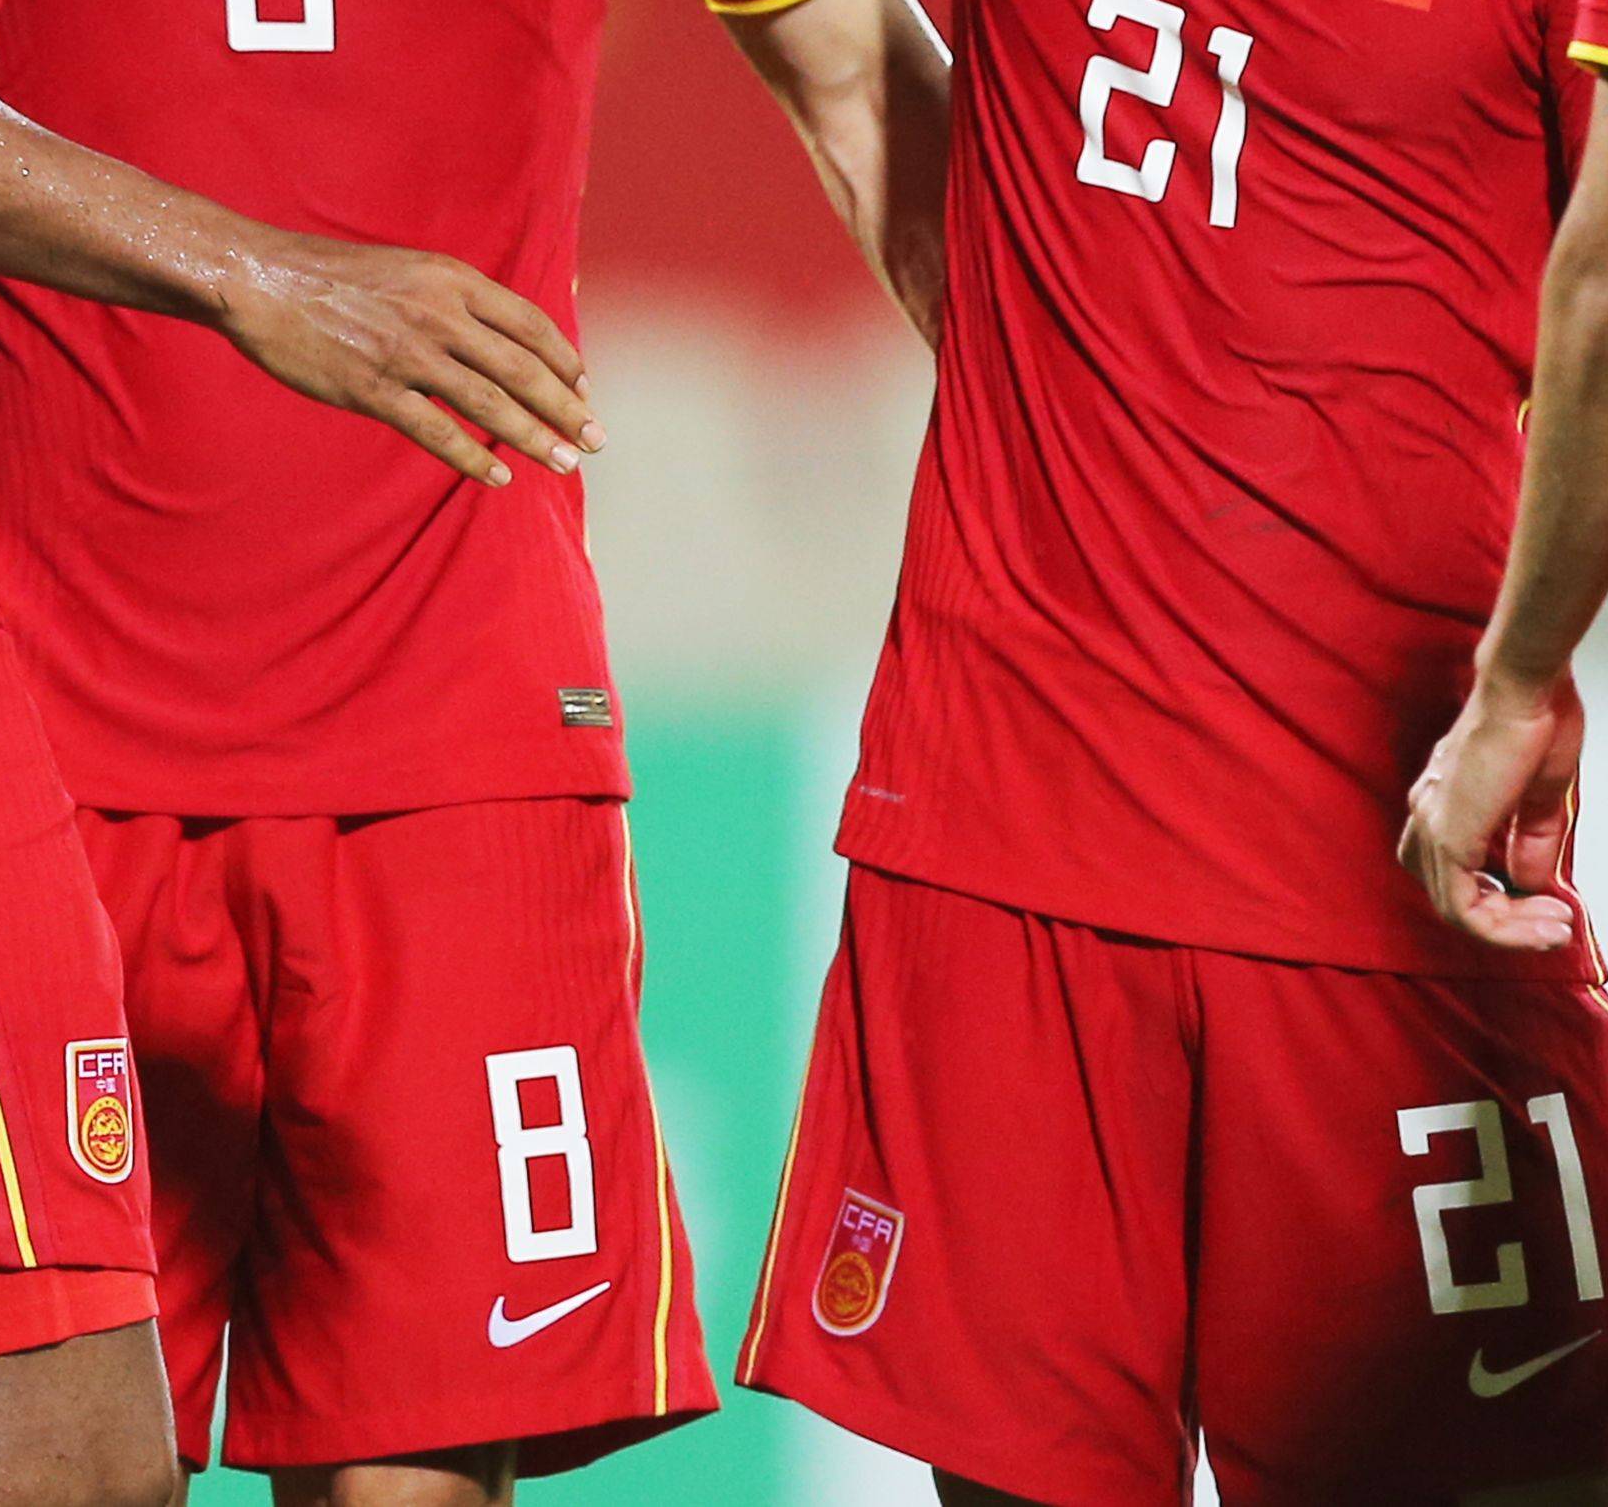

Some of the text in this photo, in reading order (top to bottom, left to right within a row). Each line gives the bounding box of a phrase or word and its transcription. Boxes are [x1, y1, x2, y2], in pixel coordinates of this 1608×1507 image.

[78, 1052, 126, 1078] CFA
[485, 1045, 597, 1263] 8
[1397, 1092, 1605, 1315] 21
[843, 1203, 893, 1244] CFA
